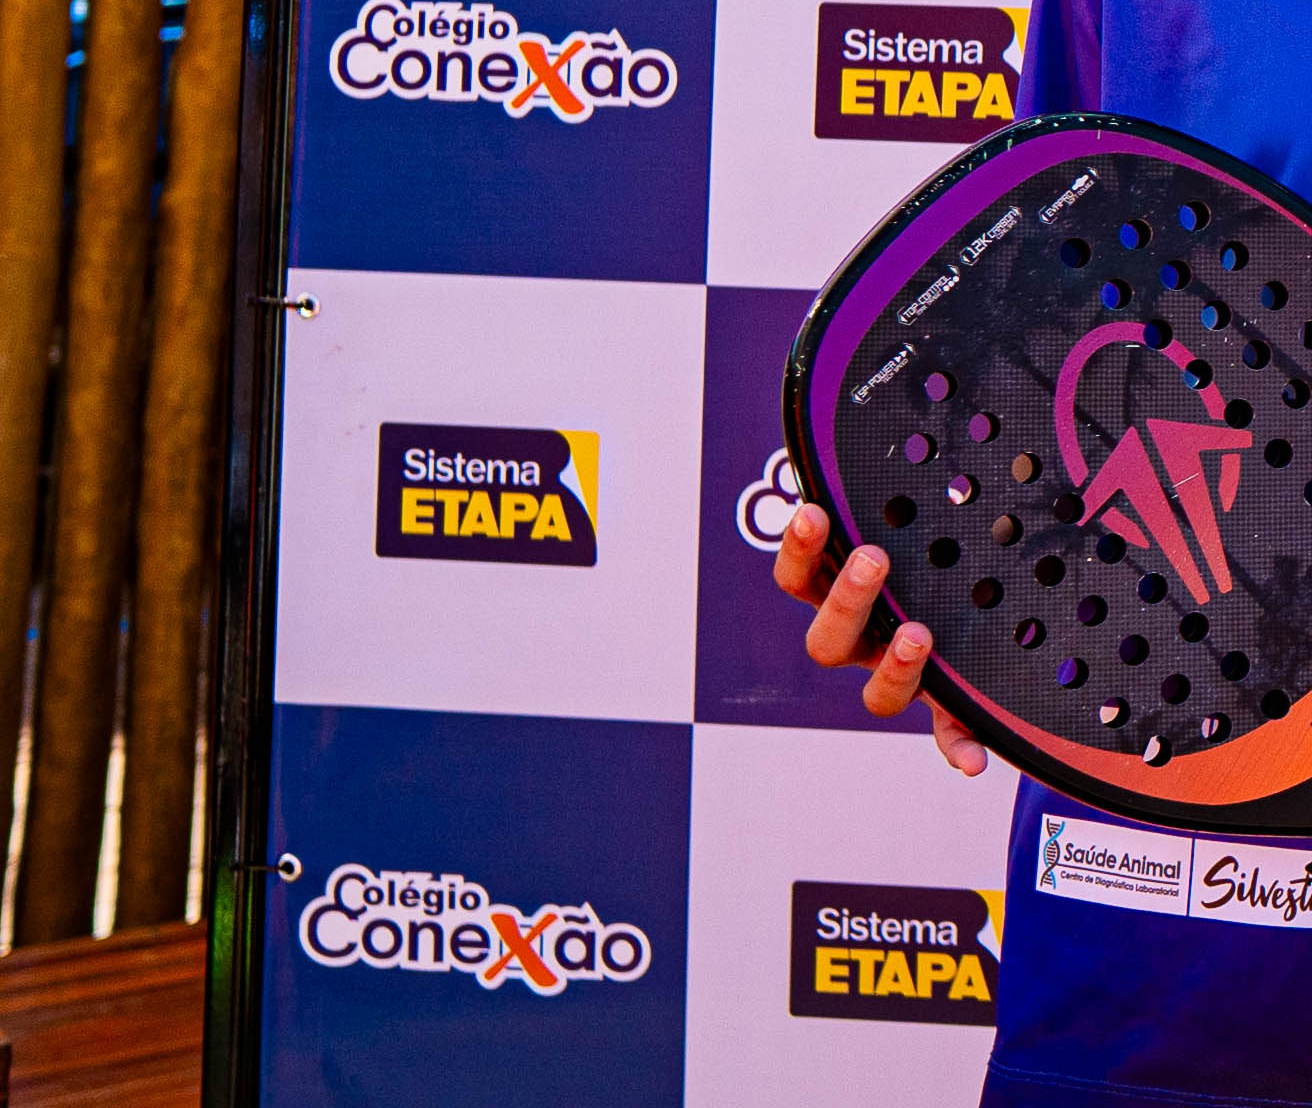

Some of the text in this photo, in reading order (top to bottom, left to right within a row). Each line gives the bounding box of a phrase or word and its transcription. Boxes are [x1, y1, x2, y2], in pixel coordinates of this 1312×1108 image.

[365, 4, 509, 46] Colégio
[844, 29, 984, 65] Sistema
[840, 69, 1014, 120] ETAPA
[970, 233, 993, 258] 12K
[403, 449, 540, 485] Sistema
[401, 489, 572, 543] ETAPA
[1064, 843, 1181, 879] Saúde Animal
[334, 872, 481, 914] Colégio
[1060, 870, 1180, 897] Centro de Diagnóstico Laboratorial
[817, 908, 957, 946] Sistema
[815, 948, 991, 1002] ETAPA
